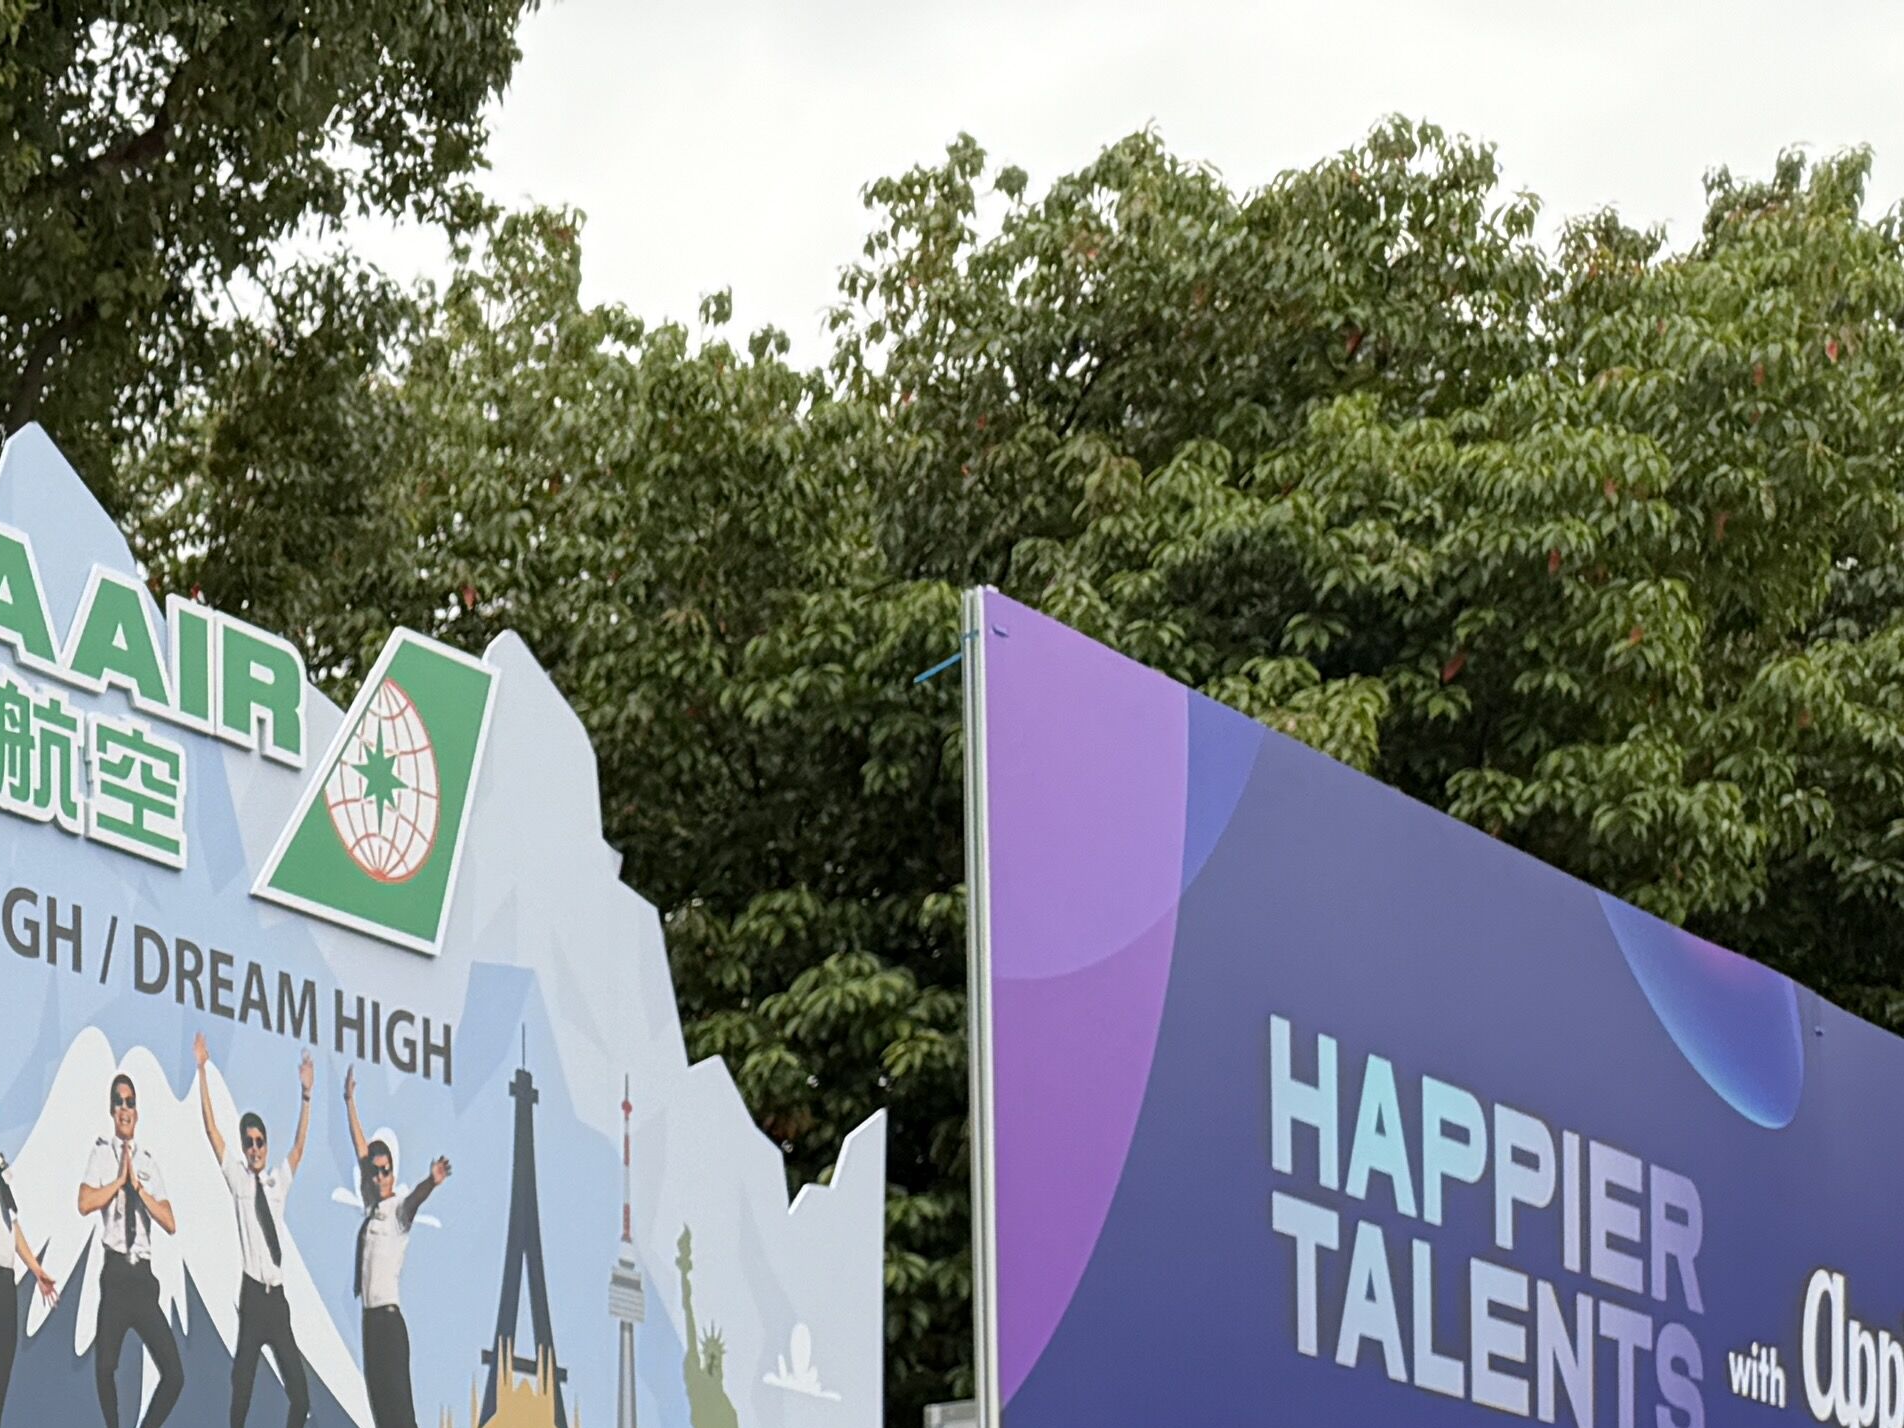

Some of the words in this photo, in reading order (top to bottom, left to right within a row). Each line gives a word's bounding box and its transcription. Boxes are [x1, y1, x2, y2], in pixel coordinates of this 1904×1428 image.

[133, 924, 319, 1046] DREAM
[335, 995, 453, 1085] HIGH
[1269, 1013, 1705, 1315] HAPPIER
[1728, 1340, 1786, 1409] with
